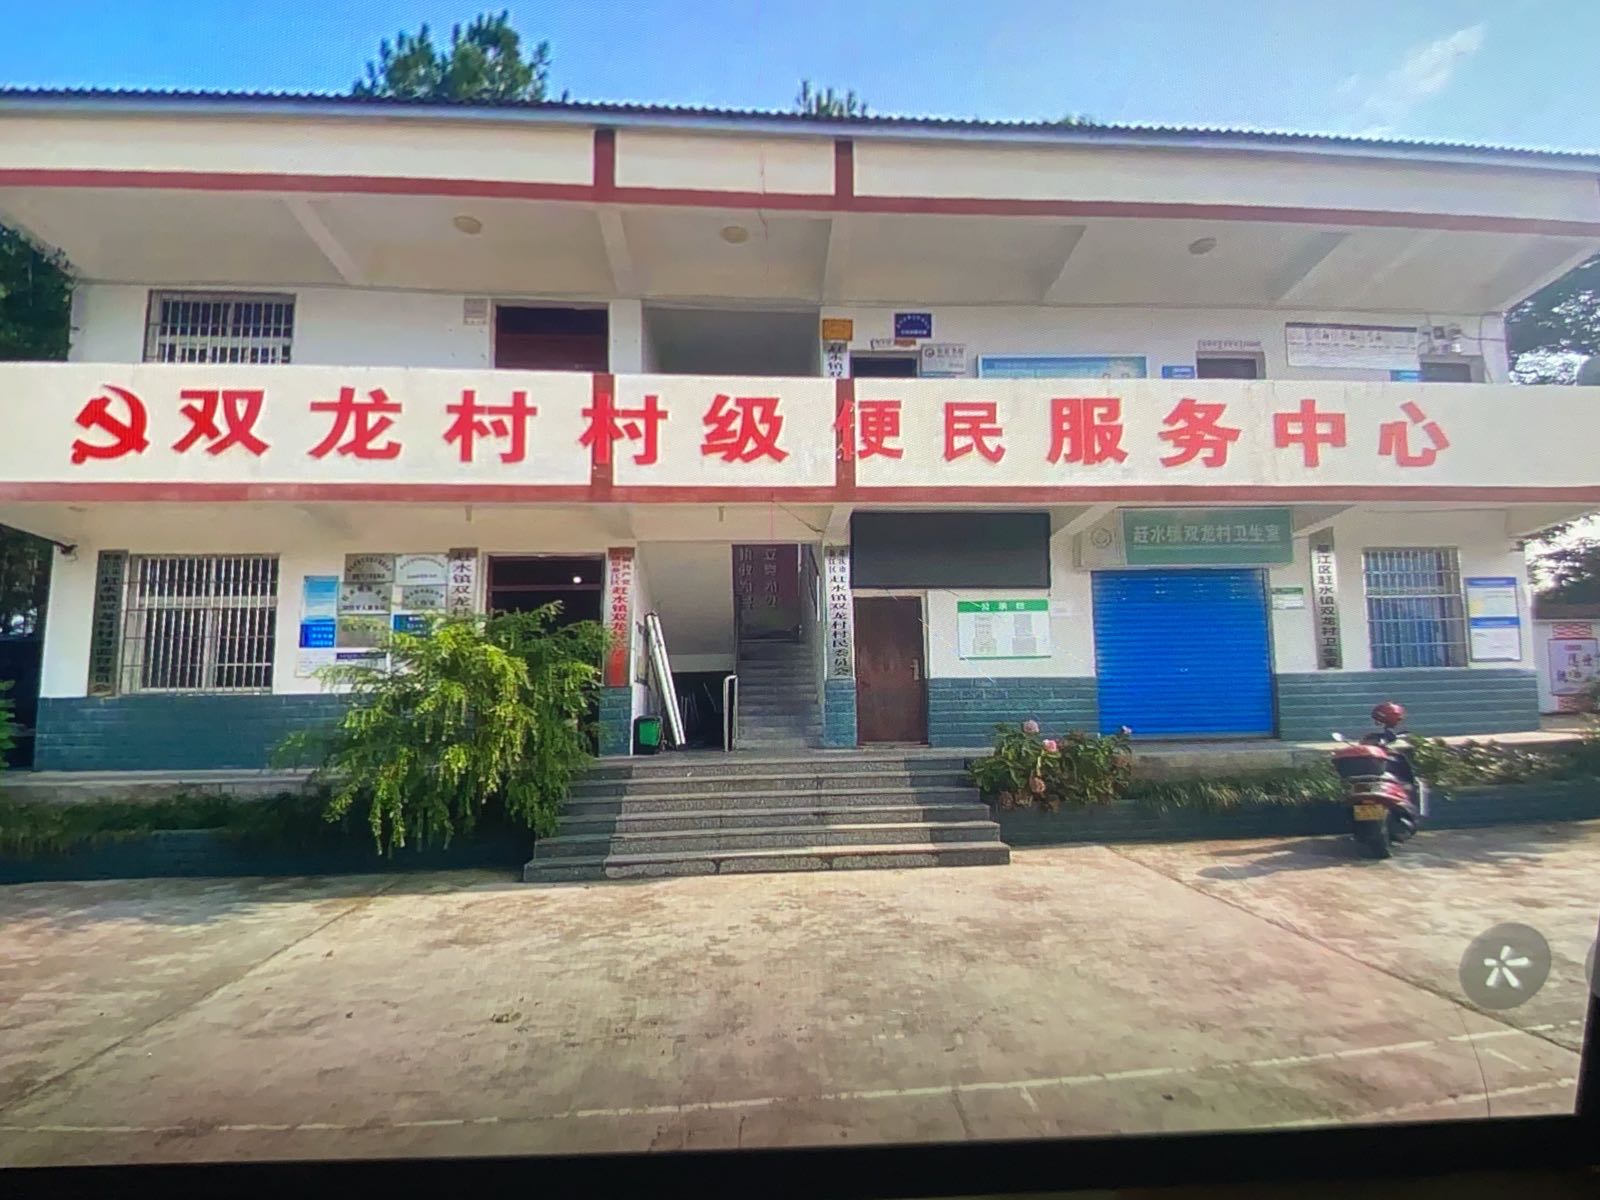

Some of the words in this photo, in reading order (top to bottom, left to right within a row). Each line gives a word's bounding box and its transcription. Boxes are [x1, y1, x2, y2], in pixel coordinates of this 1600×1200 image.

[172, 386, 1450, 469] 双龙村村级便民服务中心
